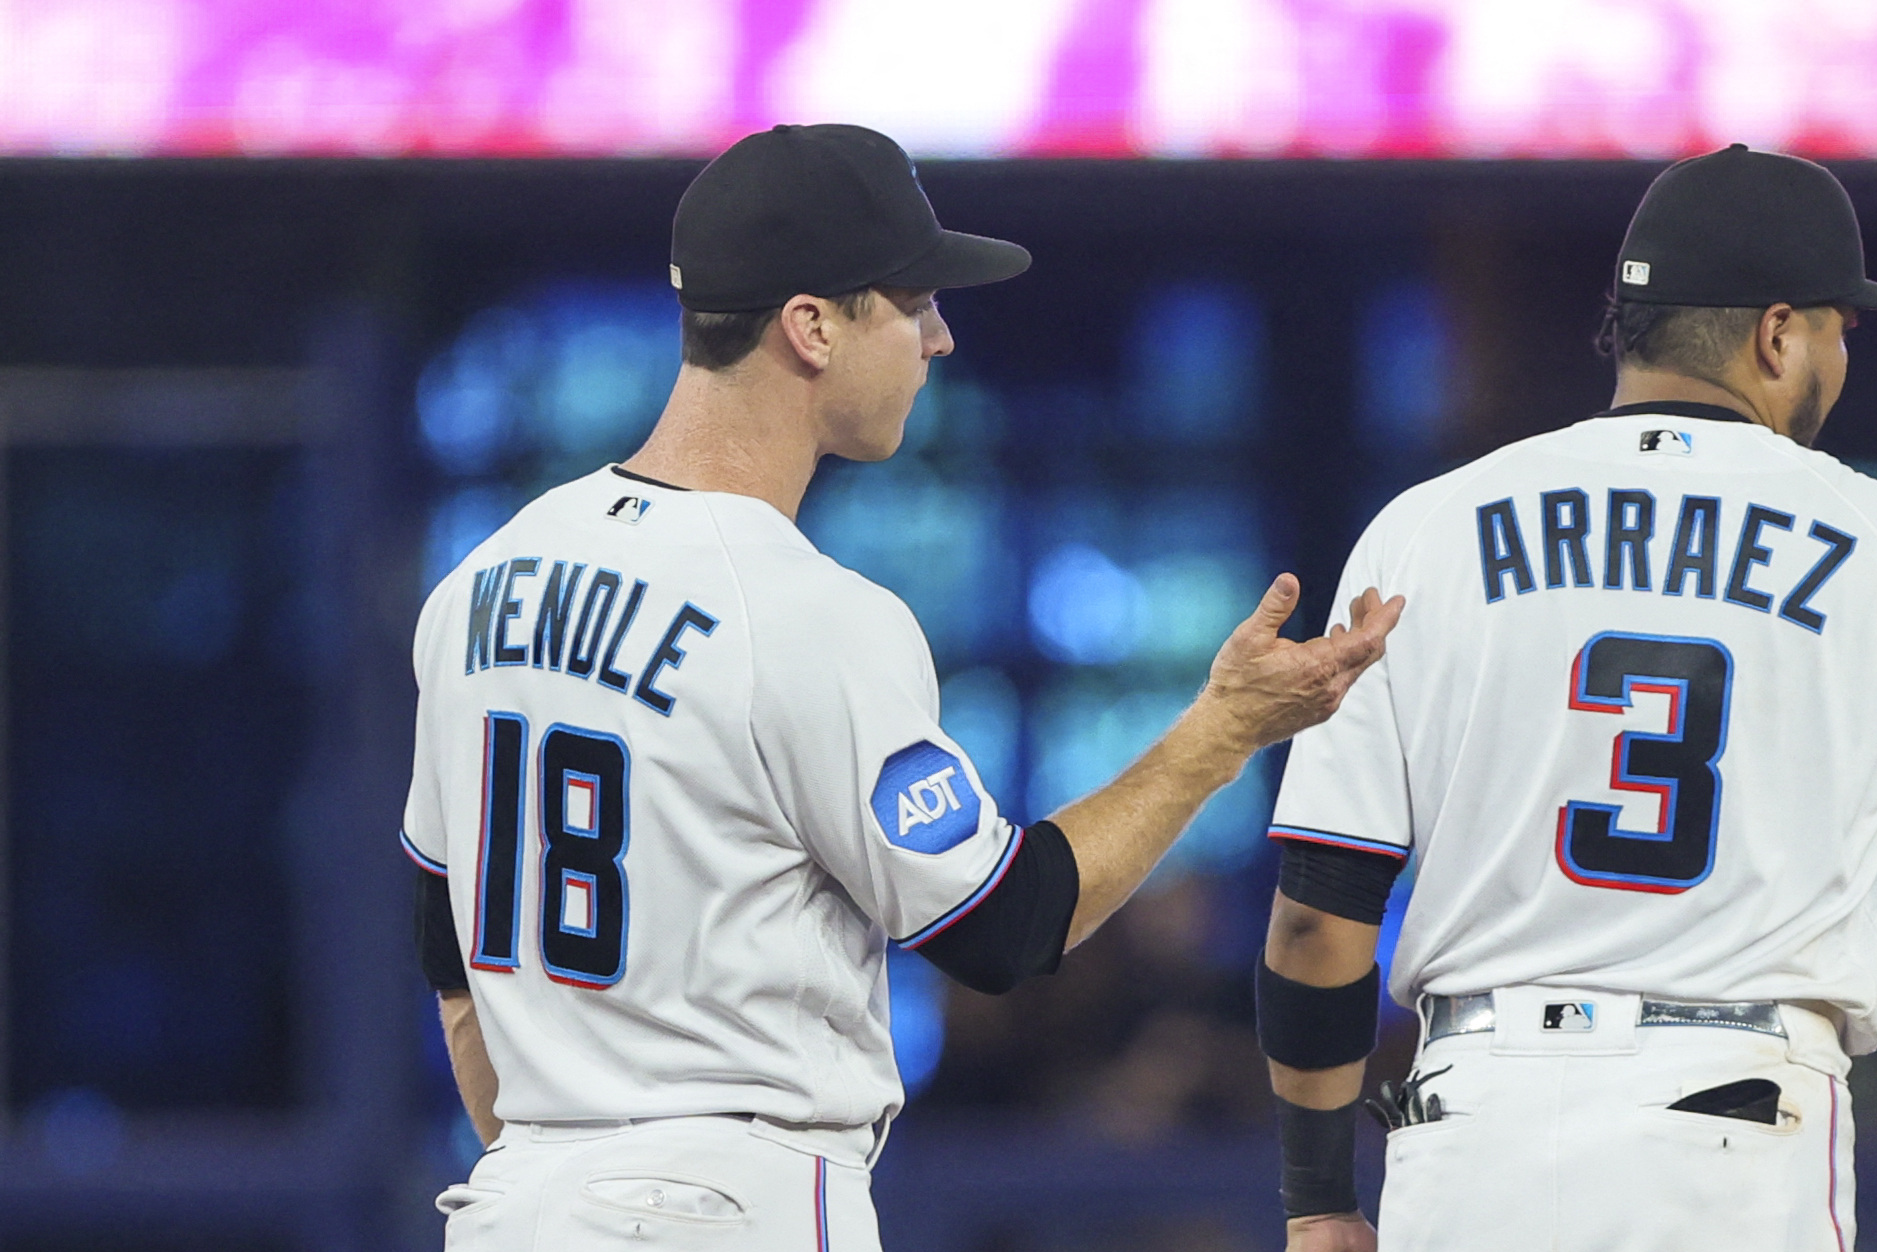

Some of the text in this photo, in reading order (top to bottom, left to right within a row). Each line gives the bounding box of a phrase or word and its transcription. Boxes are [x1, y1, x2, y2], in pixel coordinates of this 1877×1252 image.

[465, 556, 720, 717] WENDLE
[1476, 487, 1857, 635] ARRAEZ
[896, 766, 961, 838] ADT
[1555, 630, 1734, 895] 3
[470, 710, 632, 990] 18
